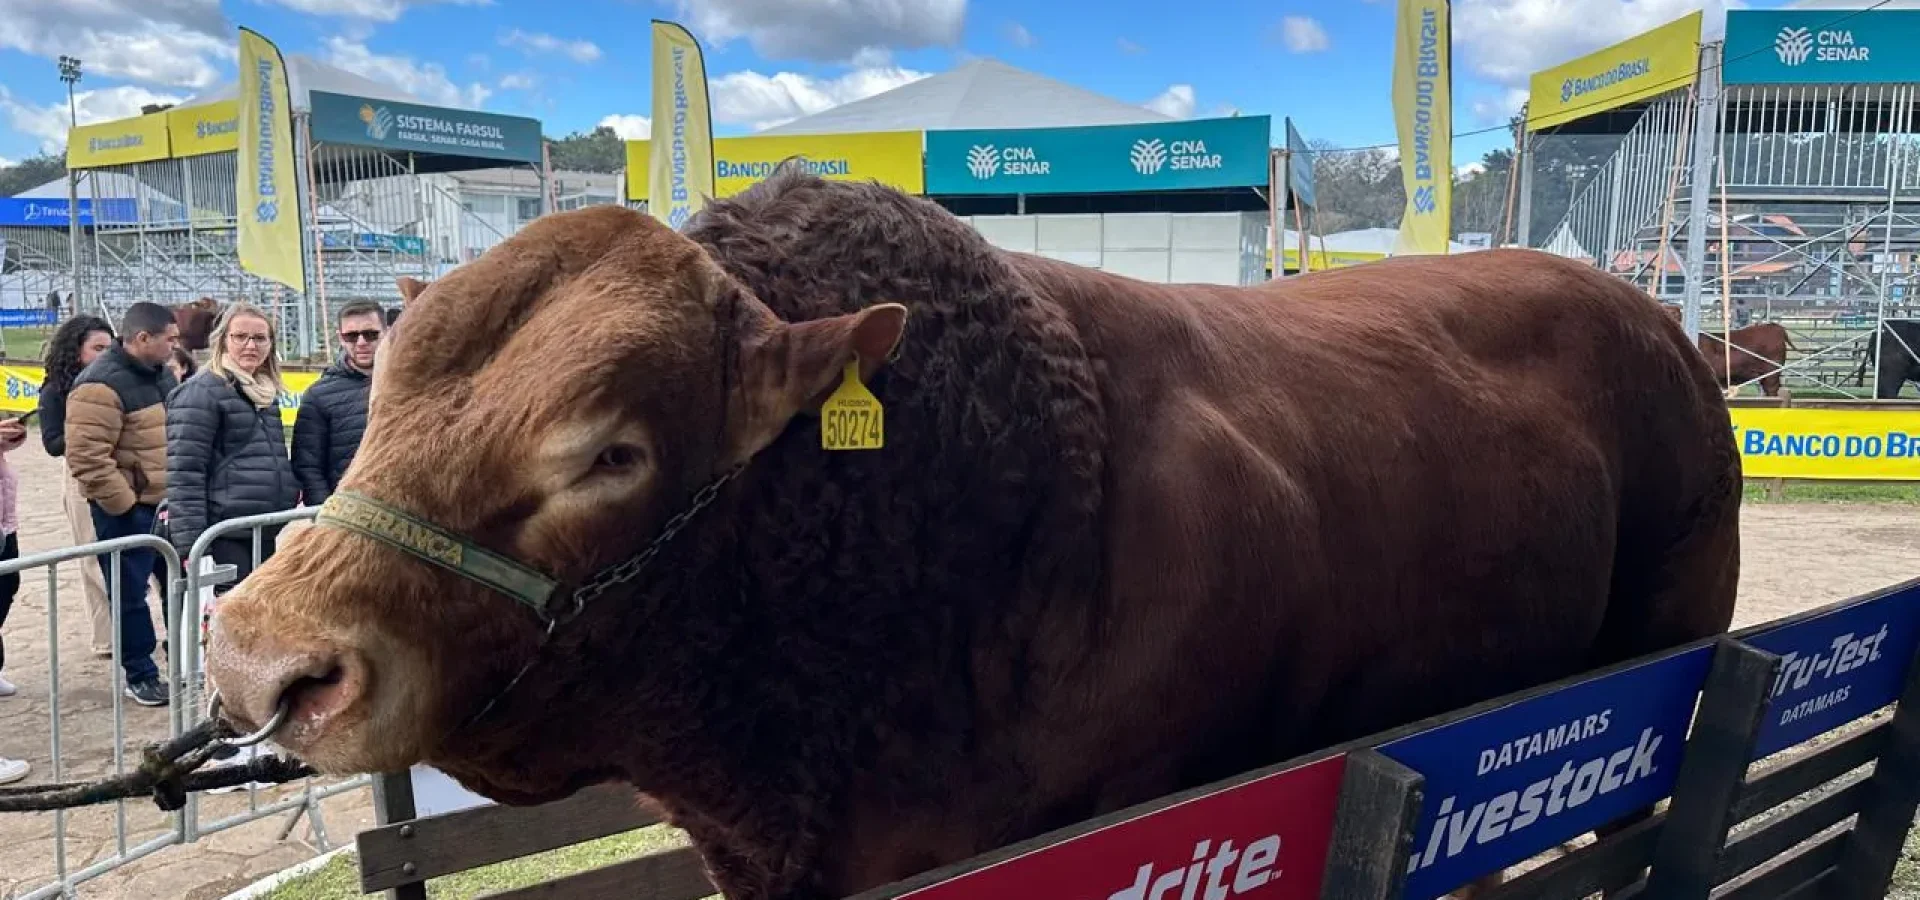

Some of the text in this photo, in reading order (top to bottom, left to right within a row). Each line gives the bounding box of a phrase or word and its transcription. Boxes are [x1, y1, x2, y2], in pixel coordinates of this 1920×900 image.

[1817, 30, 1854, 45] CNA
[1816, 47, 1870, 61] SENAR
[396, 114, 504, 139] SISTEMA FARSUL
[1003, 147, 1035, 160] CNA
[1170, 140, 1206, 154] CNA
[717, 160, 770, 177] BANCO
[1003, 161, 1050, 175] SENAR
[1170, 154, 1222, 170] SENAR
[827, 410, 880, 446] 50274
[1744, 430, 1840, 457] BANCO
[1845, 435, 1882, 457] DO
[1780, 685, 1851, 726] DATAMARS
[1477, 708, 1613, 777] DATAMARS
[1407, 726, 1663, 874] ivestock
